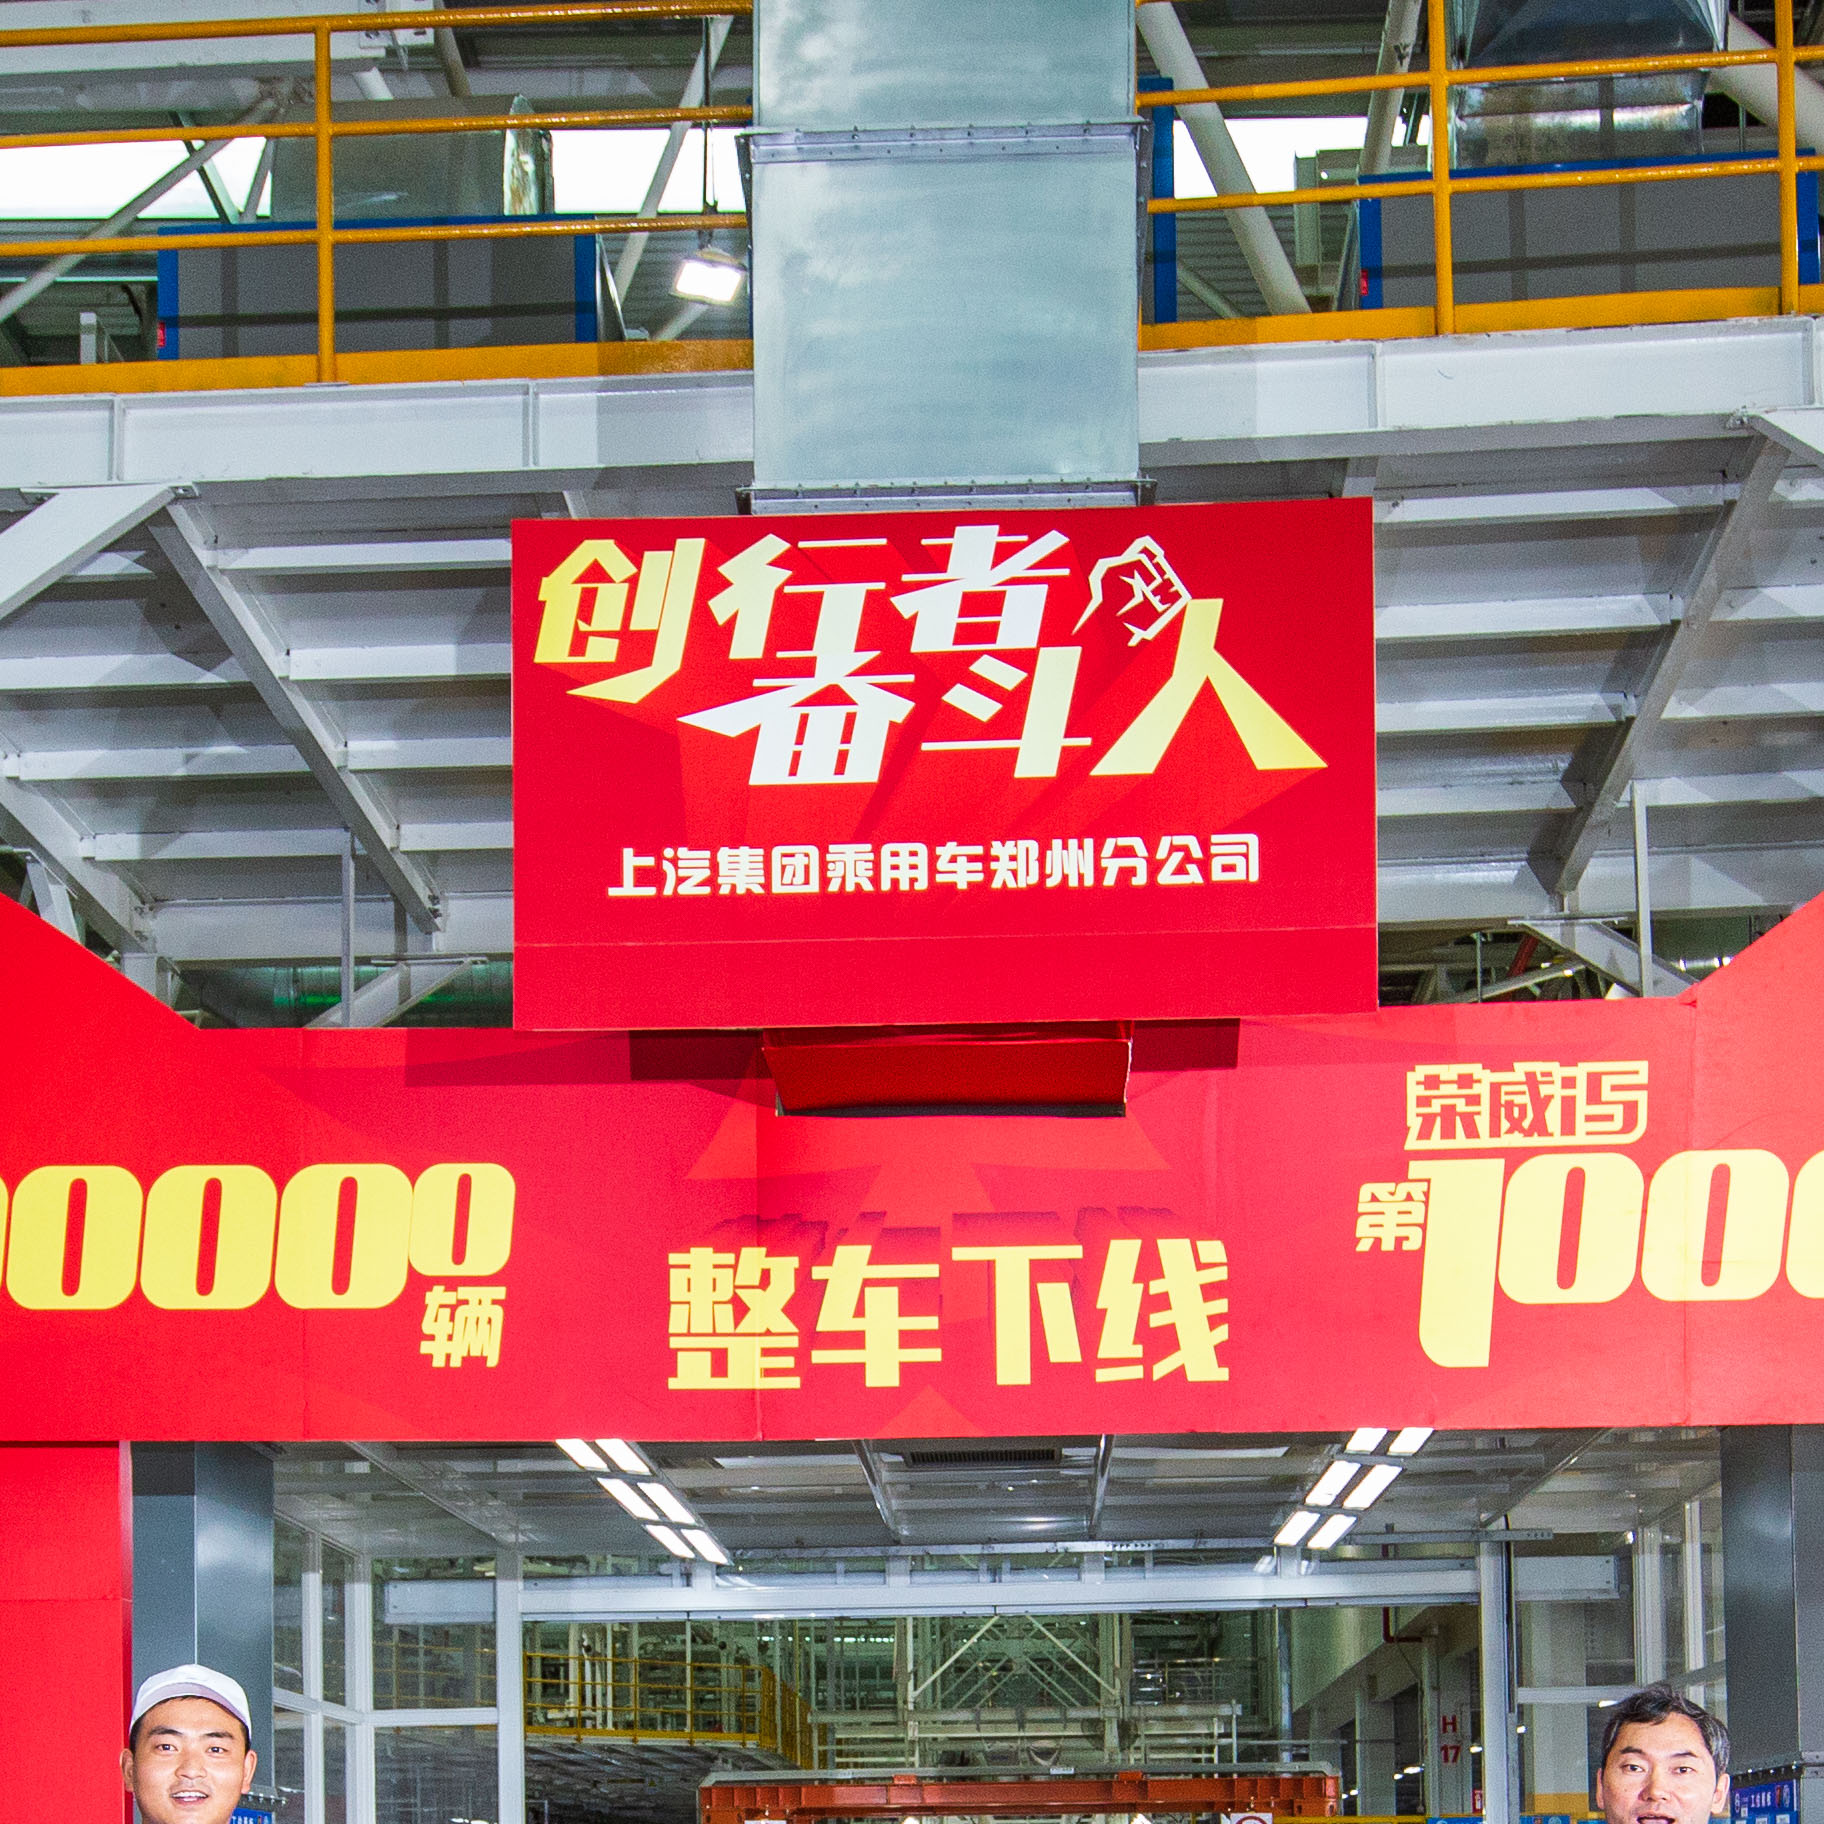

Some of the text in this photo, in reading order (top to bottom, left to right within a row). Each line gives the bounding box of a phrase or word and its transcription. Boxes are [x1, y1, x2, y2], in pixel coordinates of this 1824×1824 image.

[608, 834, 1259, 896] 上汽集团乘用车郑州分公司
[668, 1239, 1229, 1389] 整车下线
[1441, 1714, 1457, 1734] H
[1440, 1745, 1461, 1763] 17
